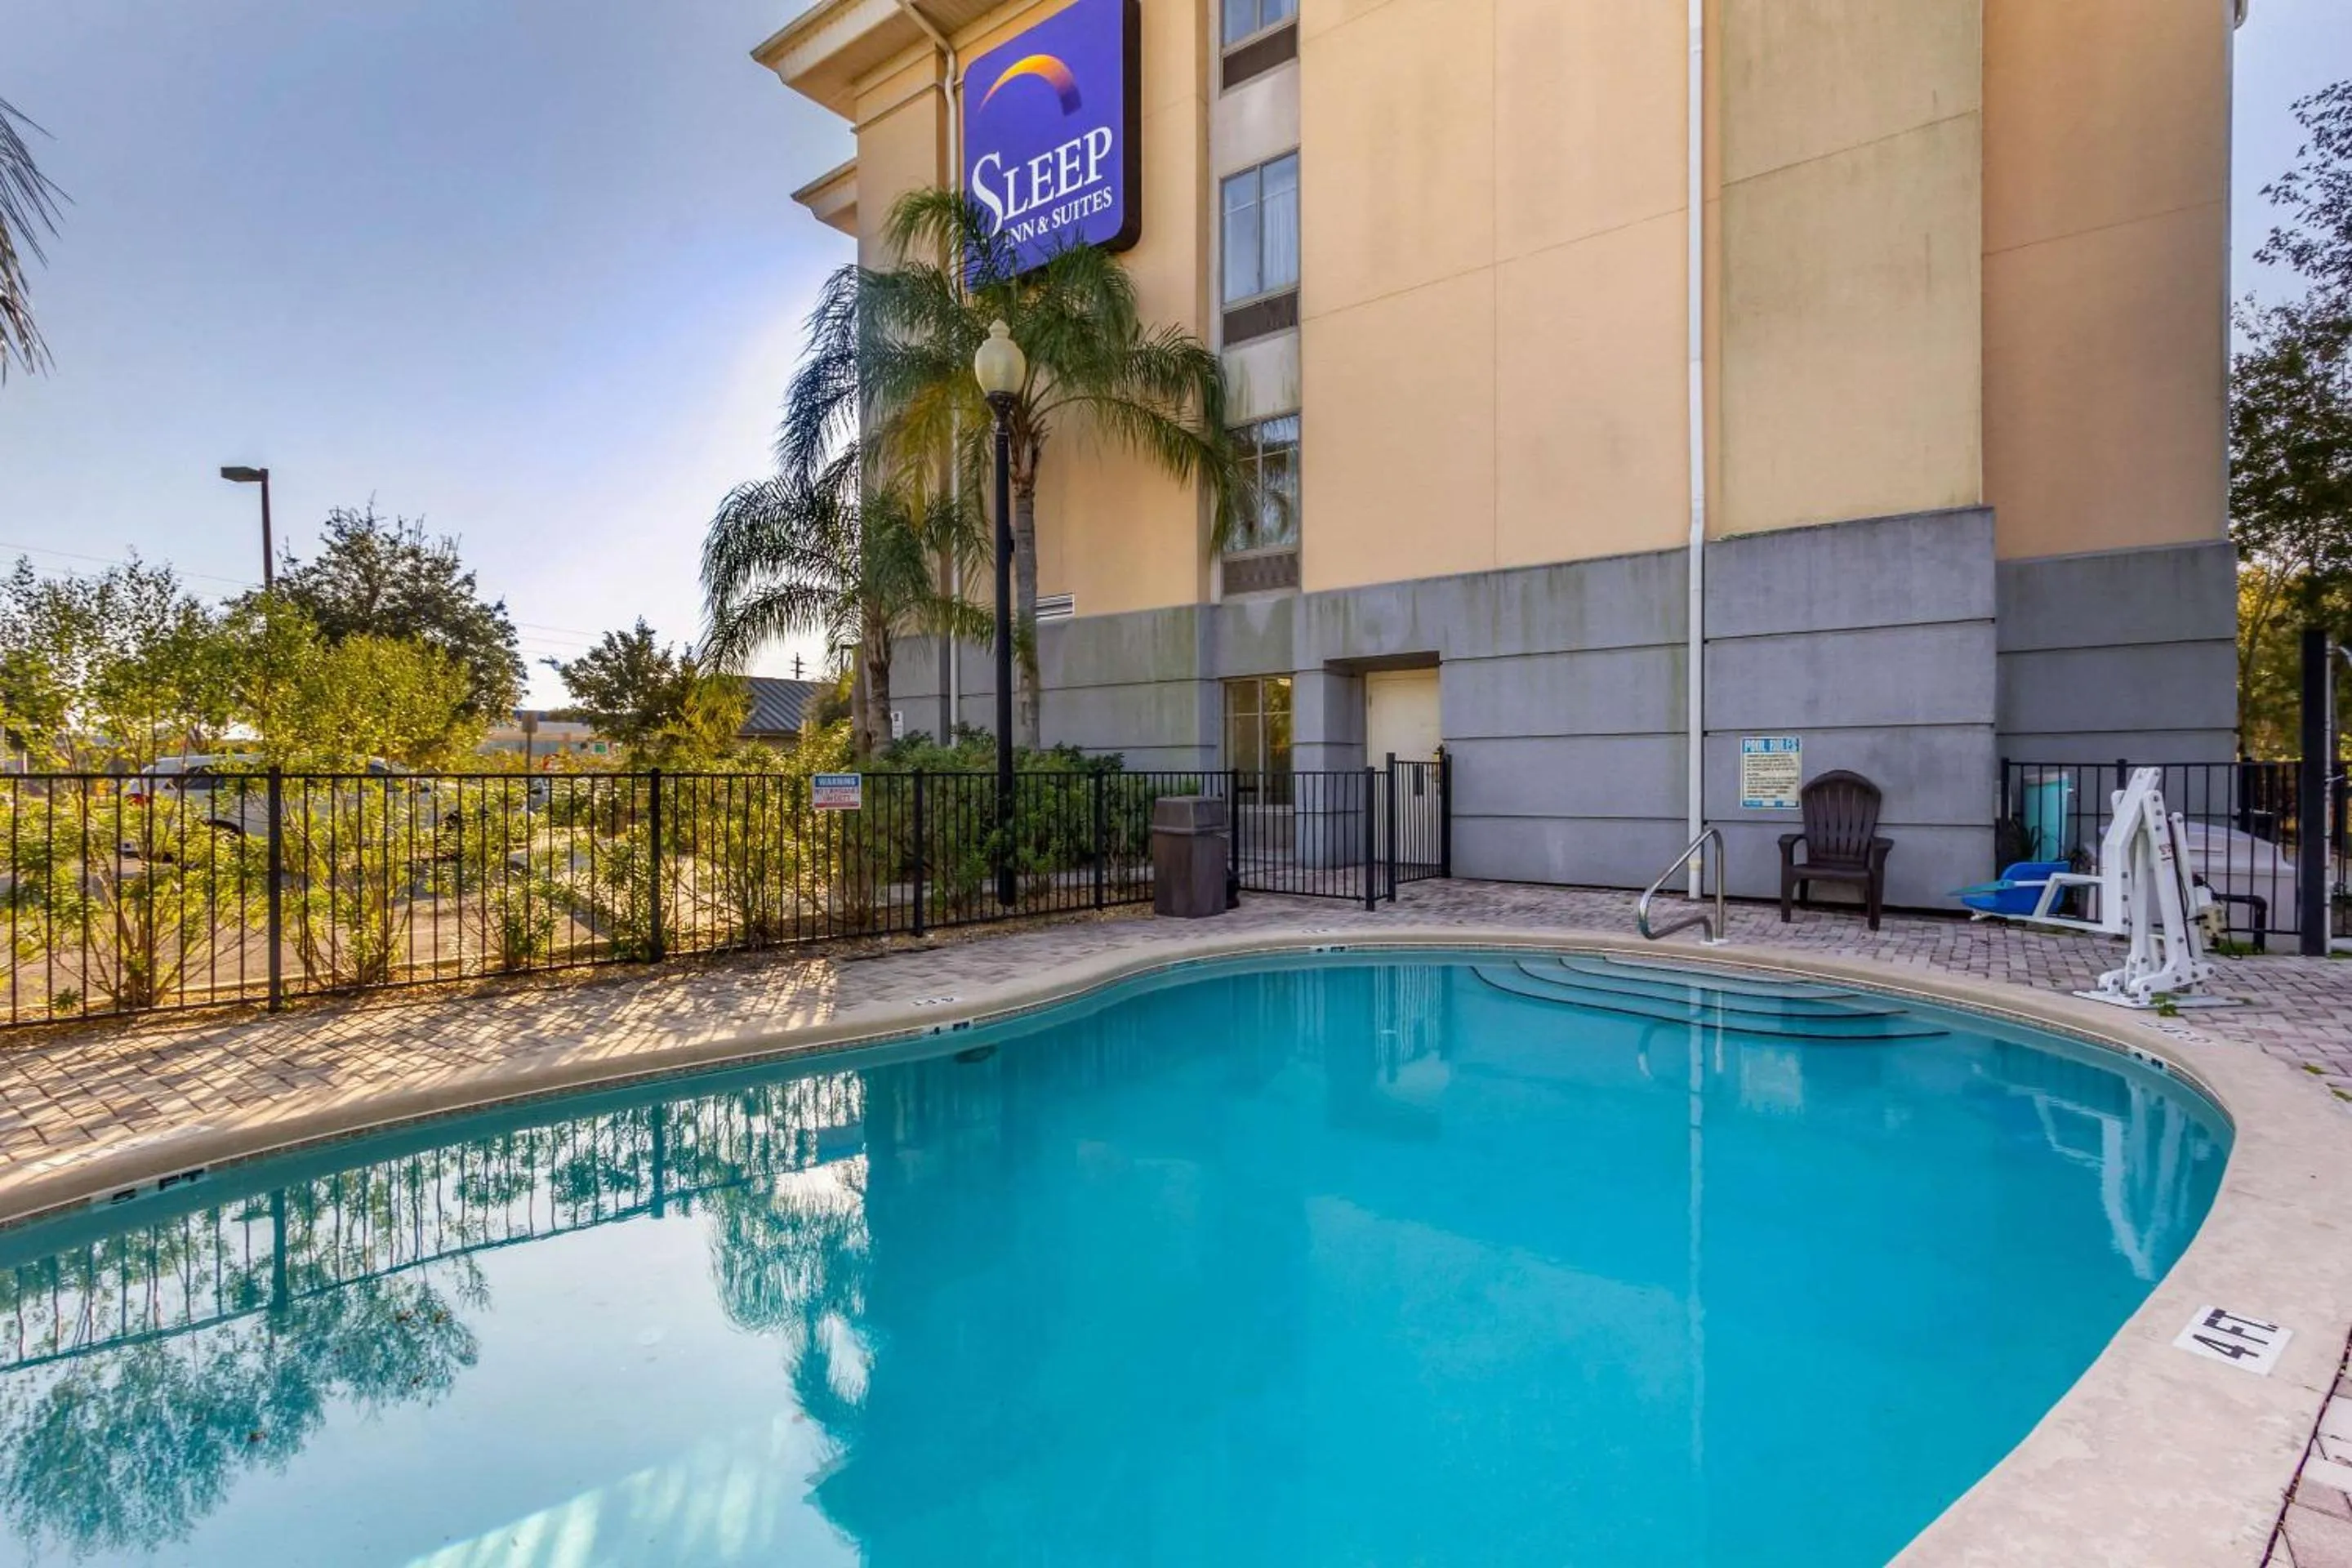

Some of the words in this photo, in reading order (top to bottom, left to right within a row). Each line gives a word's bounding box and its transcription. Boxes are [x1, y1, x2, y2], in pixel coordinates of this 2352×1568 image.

[972, 125, 1113, 239] SLEEP
[1037, 216, 1049, 234] &
[1052, 186, 1113, 229] SUITES
[2192, 1334, 2260, 1360] 4
